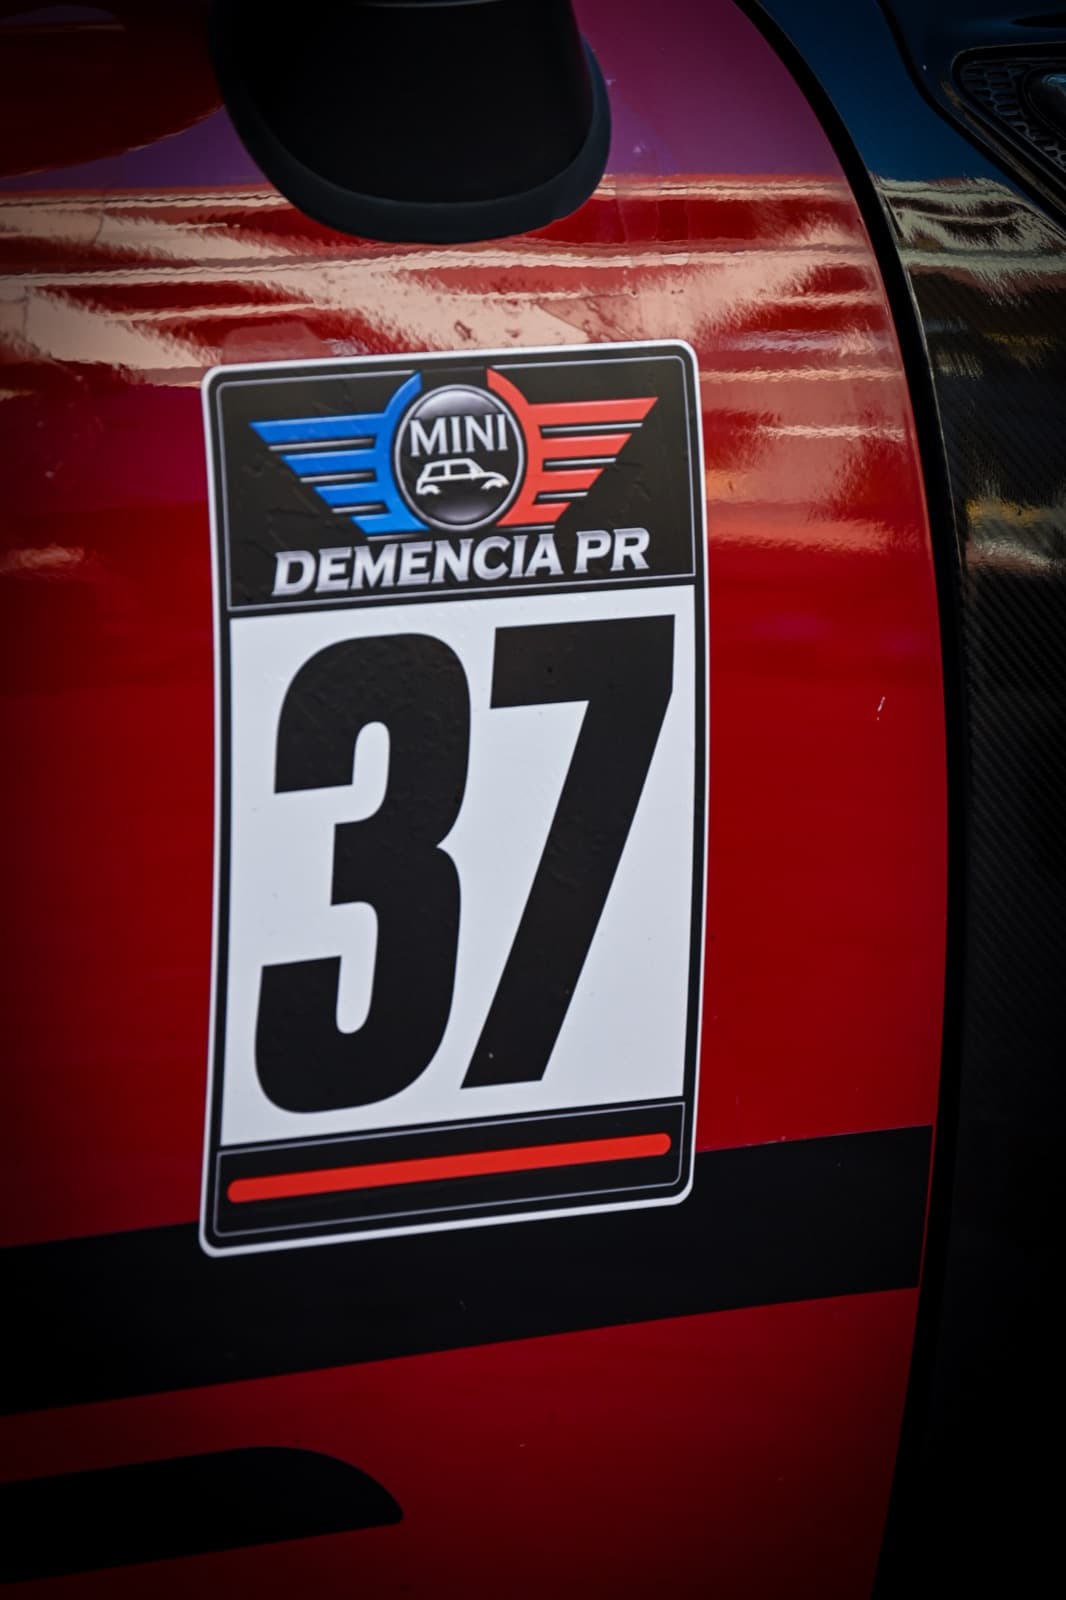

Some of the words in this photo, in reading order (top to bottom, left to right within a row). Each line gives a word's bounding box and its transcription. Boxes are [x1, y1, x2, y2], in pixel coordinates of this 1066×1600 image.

[409, 413, 508, 457] MINI
[271, 532, 563, 597] DEMENCIA
[574, 527, 651, 573] PR
[254, 614, 675, 1113] 37
